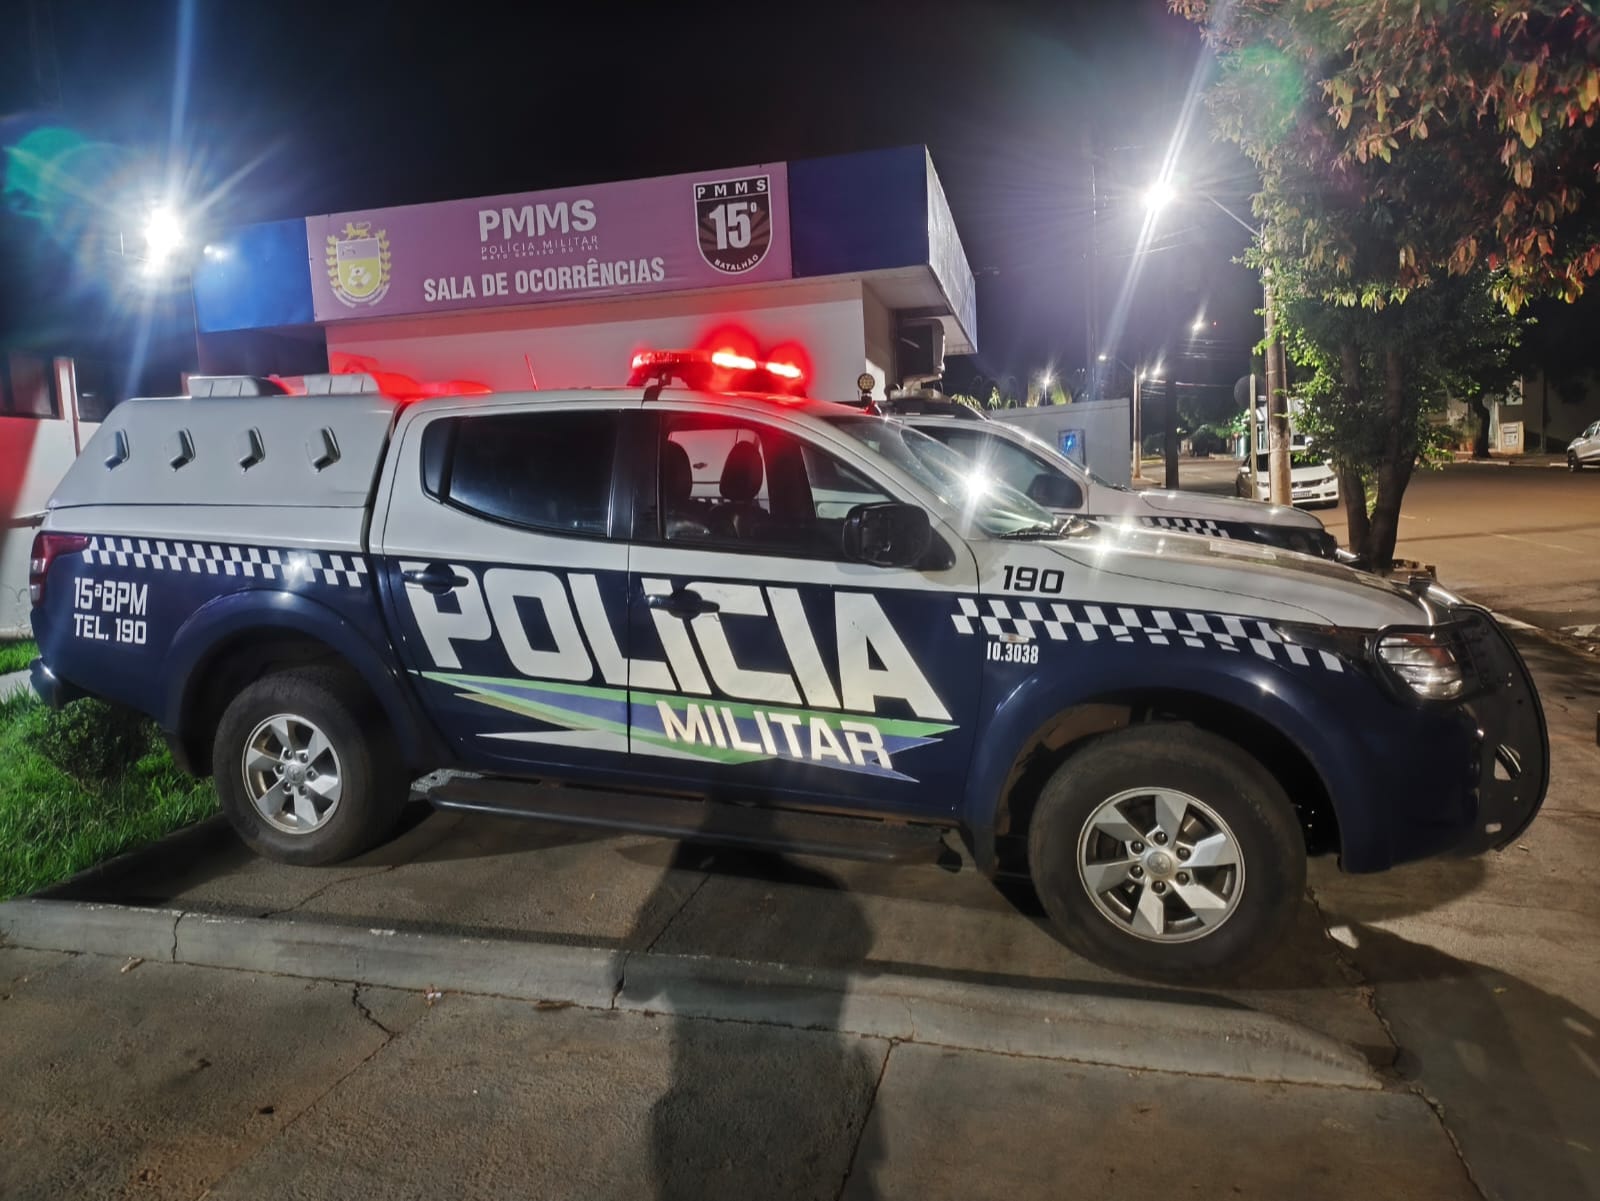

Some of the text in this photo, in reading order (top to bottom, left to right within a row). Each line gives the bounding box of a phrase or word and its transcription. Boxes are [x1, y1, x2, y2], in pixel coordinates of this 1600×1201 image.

[479, 199, 597, 242] PMMS
[542, 235, 598, 250] MILITAR
[714, 254, 758, 270] BATALHÃO
[423, 258, 665, 301] SALA DE OCORRÊNCIAS
[1003, 564, 1065, 594] 190
[73, 613, 147, 645] TEL. 190
[655, 700, 894, 769] MILITAR
